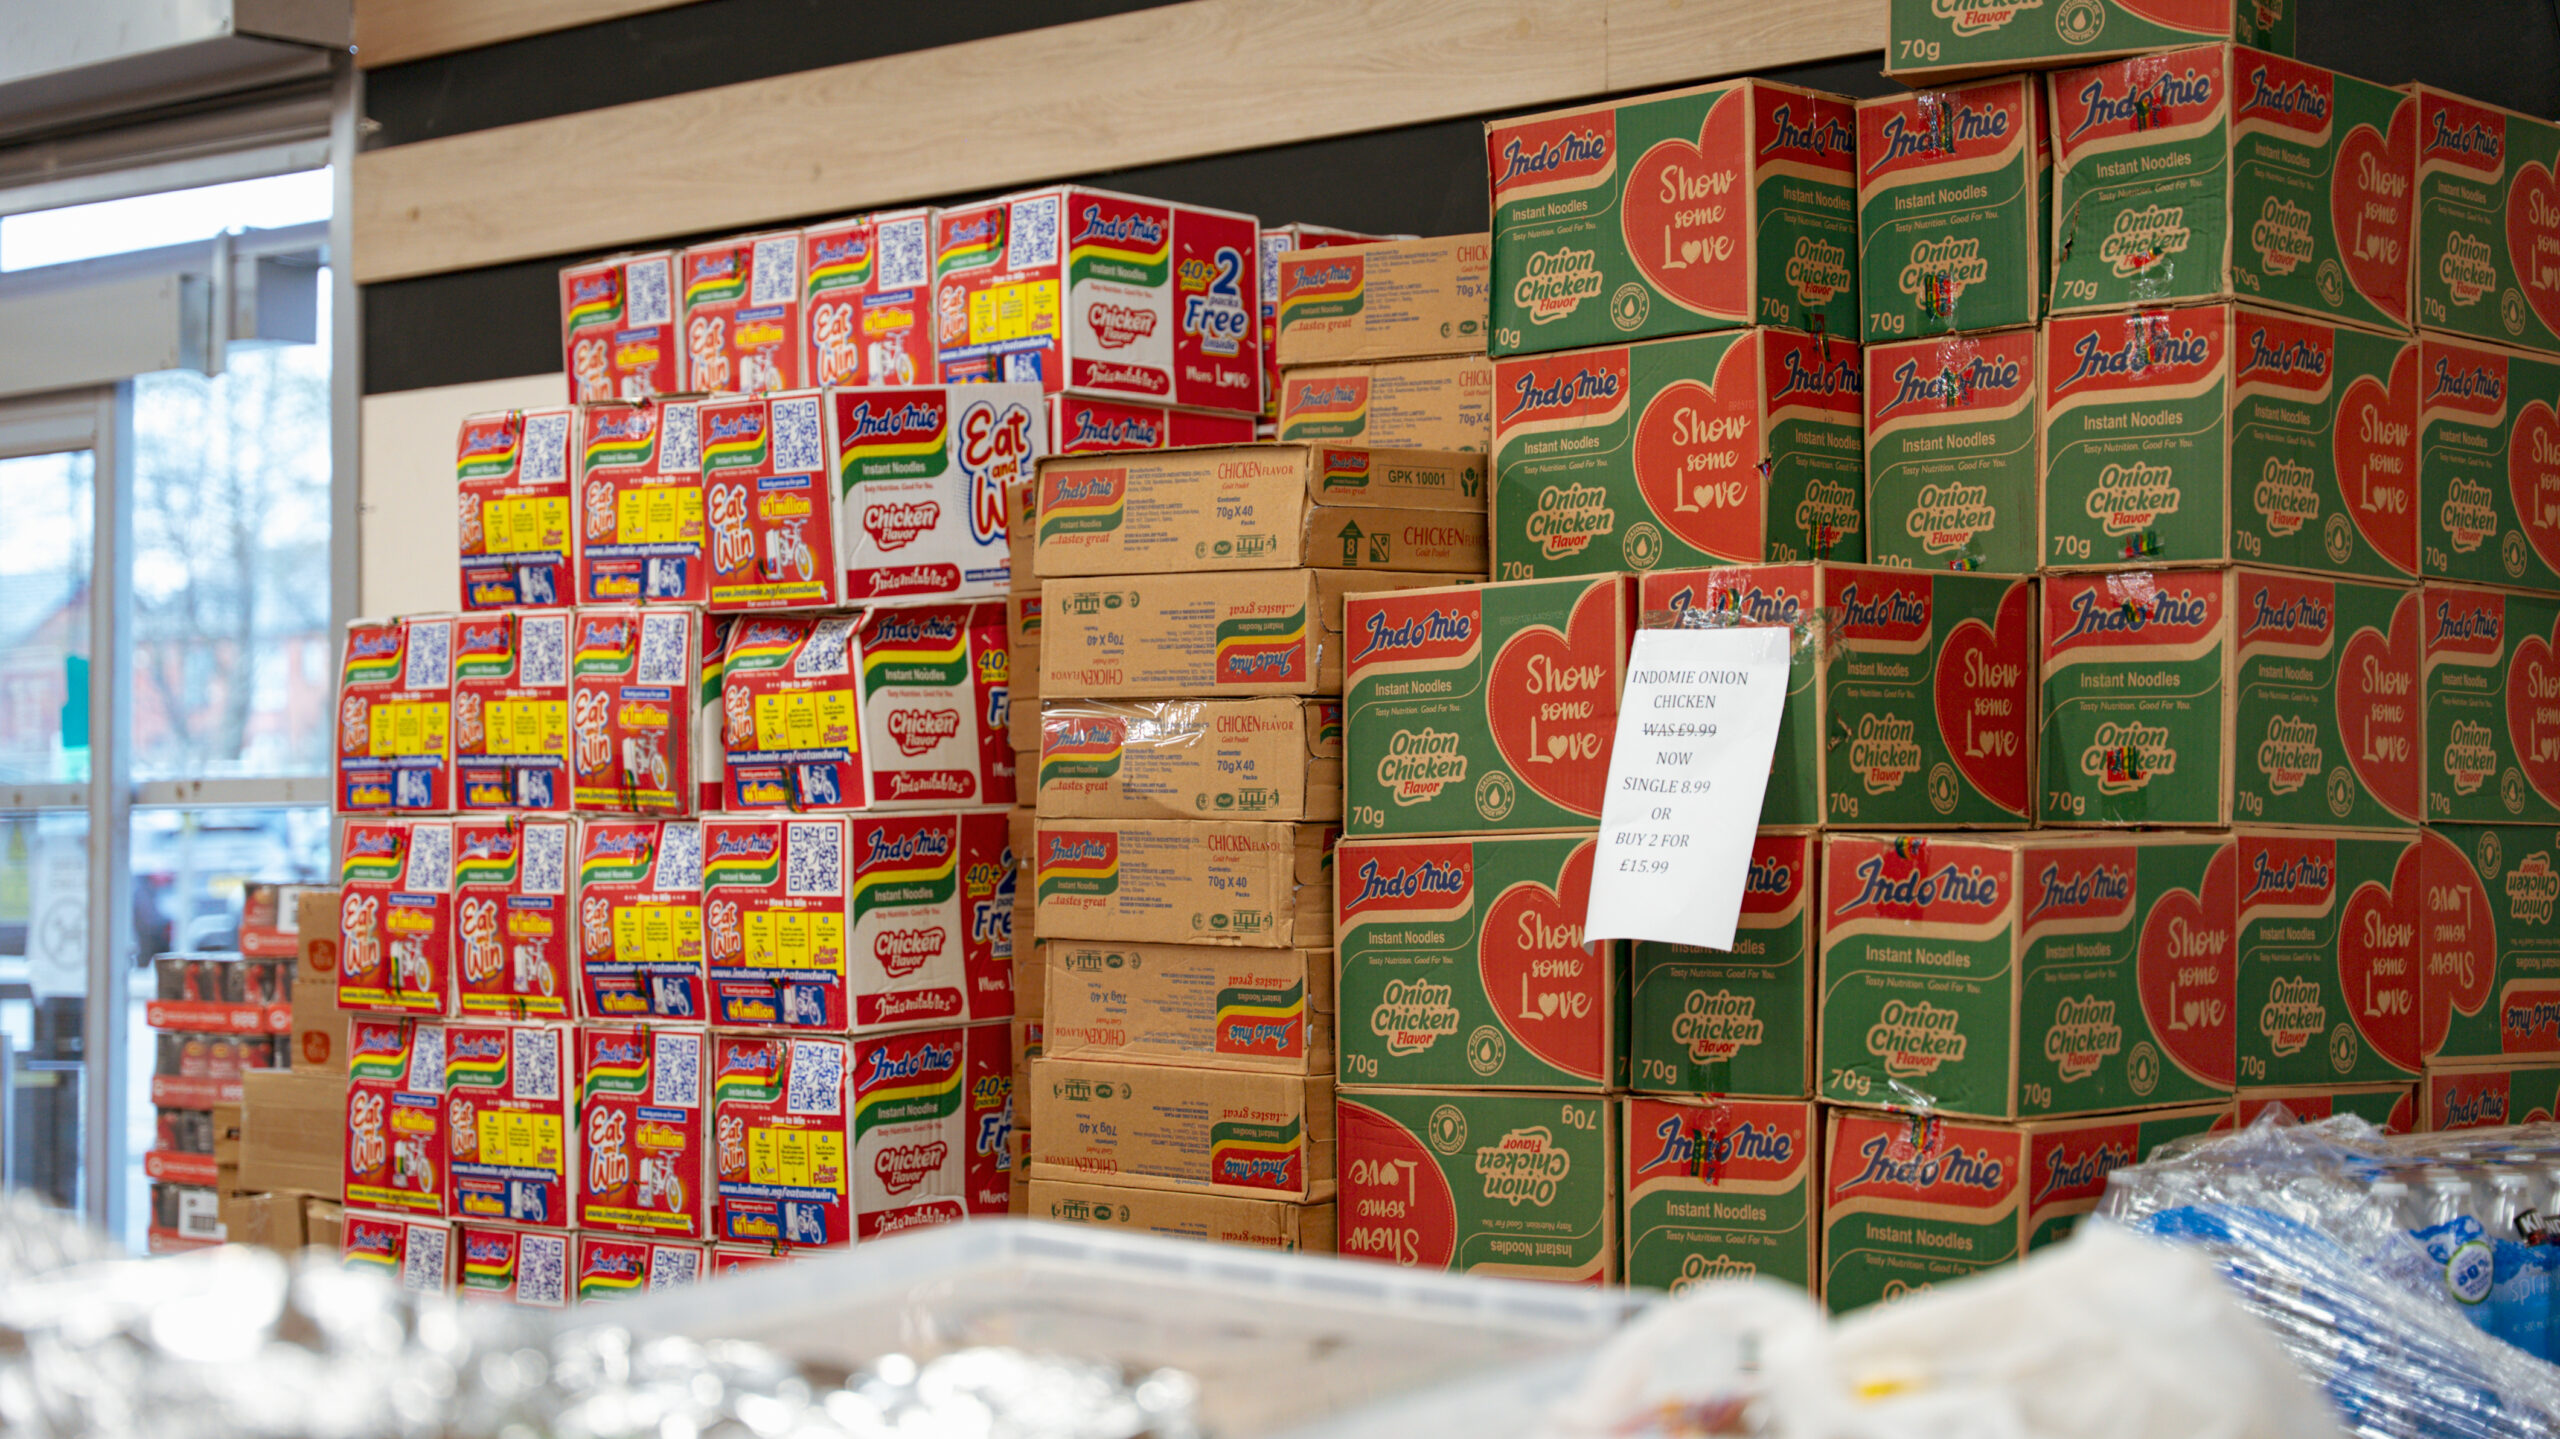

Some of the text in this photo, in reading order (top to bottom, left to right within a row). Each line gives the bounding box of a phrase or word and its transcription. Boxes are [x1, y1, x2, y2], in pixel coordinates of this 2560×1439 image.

[1964, 9, 2011, 26] Flavor
[1900, 39, 1941, 61] 70g
[2096, 152, 2192, 178] Instant Noodles
[2358, 152, 2409, 198] Show
[1660, 164, 1737, 204] Show
[1512, 200, 1588, 221] Instant Noodles
[1674, 205, 1725, 228] some
[2115, 206, 2179, 234] Onion
[2264, 198, 2310, 229] Onion
[2365, 202, 2399, 225] some
[2254, 222, 2312, 254] Chicken
[1213, 251, 1238, 295] 2
[1529, 250, 1593, 277] Onion
[1517, 273, 1599, 302] Chicken
[2061, 280, 2098, 299] 70g
[1540, 296, 1576, 311] Flavor
[1090, 305, 1152, 331] Chicken
[1186, 298, 1245, 333] Free
[1328, 319, 1352, 333] great
[1870, 313, 1905, 333] 70g
[1672, 406, 1751, 446] Show
[2084, 410, 2183, 431] Instant Noodles
[2360, 403, 2411, 447] Show
[966, 409, 1025, 466] Eat
[1524, 436, 1600, 455] Instant Noodles
[862, 461, 926, 474] Instant Noodles
[992, 457, 1018, 478] and
[1218, 461, 1294, 479] CHICKEN FLAVOR
[1688, 449, 1739, 471] some
[1388, 470, 1445, 485] GPK 10001
[2101, 464, 2171, 489] Onion
[2265, 458, 2313, 488] Onion
[712, 488, 744, 525] Eat
[1539, 484, 1605, 511] Onion
[2088, 487, 2179, 514] Chicken
[2256, 483, 2319, 513] Chicken
[866, 506, 934, 528] Chicken
[1217, 505, 1253, 520] 70g X 40
[1529, 508, 1613, 536] Chicken
[2112, 512, 2151, 526] Flavor
[2273, 509, 2300, 527] Flavor
[882, 528, 916, 540] Flavor
[1085, 533, 1110, 547] great
[1403, 526, 1464, 546] CHICKEN
[1551, 533, 1587, 549] Flavor
[1932, 531, 1969, 545] Flavor
[717, 530, 752, 568] Win
[2055, 536, 2091, 557] 70g
[1229, 603, 1255, 616] great
[885, 667, 946, 681] Instant Noodles
[1526, 654, 1606, 694] Show
[1632, 670, 1748, 685] INDOMIE ONION
[1964, 648, 2021, 689] Show
[1375, 680, 1452, 696] Instant Noodles
[1541, 700, 1594, 722] some
[1653, 695, 1716, 709] CHICKEN
[1974, 698, 2013, 717] some
[891, 714, 954, 734] Chicken
[1216, 715, 1294, 733] CHICKEN FLAVOR
[1643, 723, 1717, 738] WAS £9.99
[1860, 715, 1913, 742] Onion
[2097, 723, 2166, 747] Onion
[906, 734, 936, 746] Flavor
[1391, 729, 1457, 754] Onion
[1217, 760, 1254, 773] 70g X 40
[1656, 752, 1692, 765] NOW
[1853, 741, 1920, 770] Chicken
[1380, 756, 1465, 781] Chicken
[1871, 768, 1901, 782] Flavor
[1085, 781, 1108, 794] great
[1403, 781, 1440, 794] Flavor
[1623, 776, 1711, 794] SINGLE 8.99
[1651, 808, 1671, 820] OR
[1830, 793, 1858, 818] 70g
[2049, 792, 2085, 814] 70g
[1353, 806, 1384, 827] 70g
[1208, 835, 1251, 852] CHICKEN
[1615, 832, 1690, 848] BUY 2 FOR
[1619, 859, 1669, 874] £15.99
[1208, 876, 1247, 889] 70g X 40
[875, 888, 934, 901] Instant Noodles
[462, 902, 496, 934] Eat
[710, 902, 735, 927] Eat
[876, 932, 940, 955] Chicken
[1368, 930, 1445, 944] Instant Noodles
[2167, 917, 2229, 958] Show
[891, 955, 922, 967] Flavor
[1866, 945, 1971, 968] Instant Noodles
[2373, 956, 2408, 976] some
[1532, 959, 1584, 978] some
[1385, 981, 1450, 1005] Onion
[1686, 992, 1754, 1016] Onion
[1883, 1002, 1957, 1030] Onion
[1396, 1032, 1432, 1045] Flavor
[1674, 1018, 1762, 1040] Chicken
[1697, 1040, 1735, 1053] Flavor
[1868, 1028, 1965, 1056] Chicken
[1347, 1054, 1378, 1077] 70g
[1641, 1059, 1677, 1084] 70g
[1831, 1069, 1871, 1096] 70g
[1562, 1104, 1597, 1130] 70g
[1503, 1139, 1541, 1153] Flavor
[877, 1149, 942, 1173] Chicken
[1477, 1152, 1566, 1176] Chicken
[1486, 1177, 1554, 1205] Onion
[1357, 1200, 1405, 1219] some
[1866, 1223, 1973, 1251] Instant Noodles
